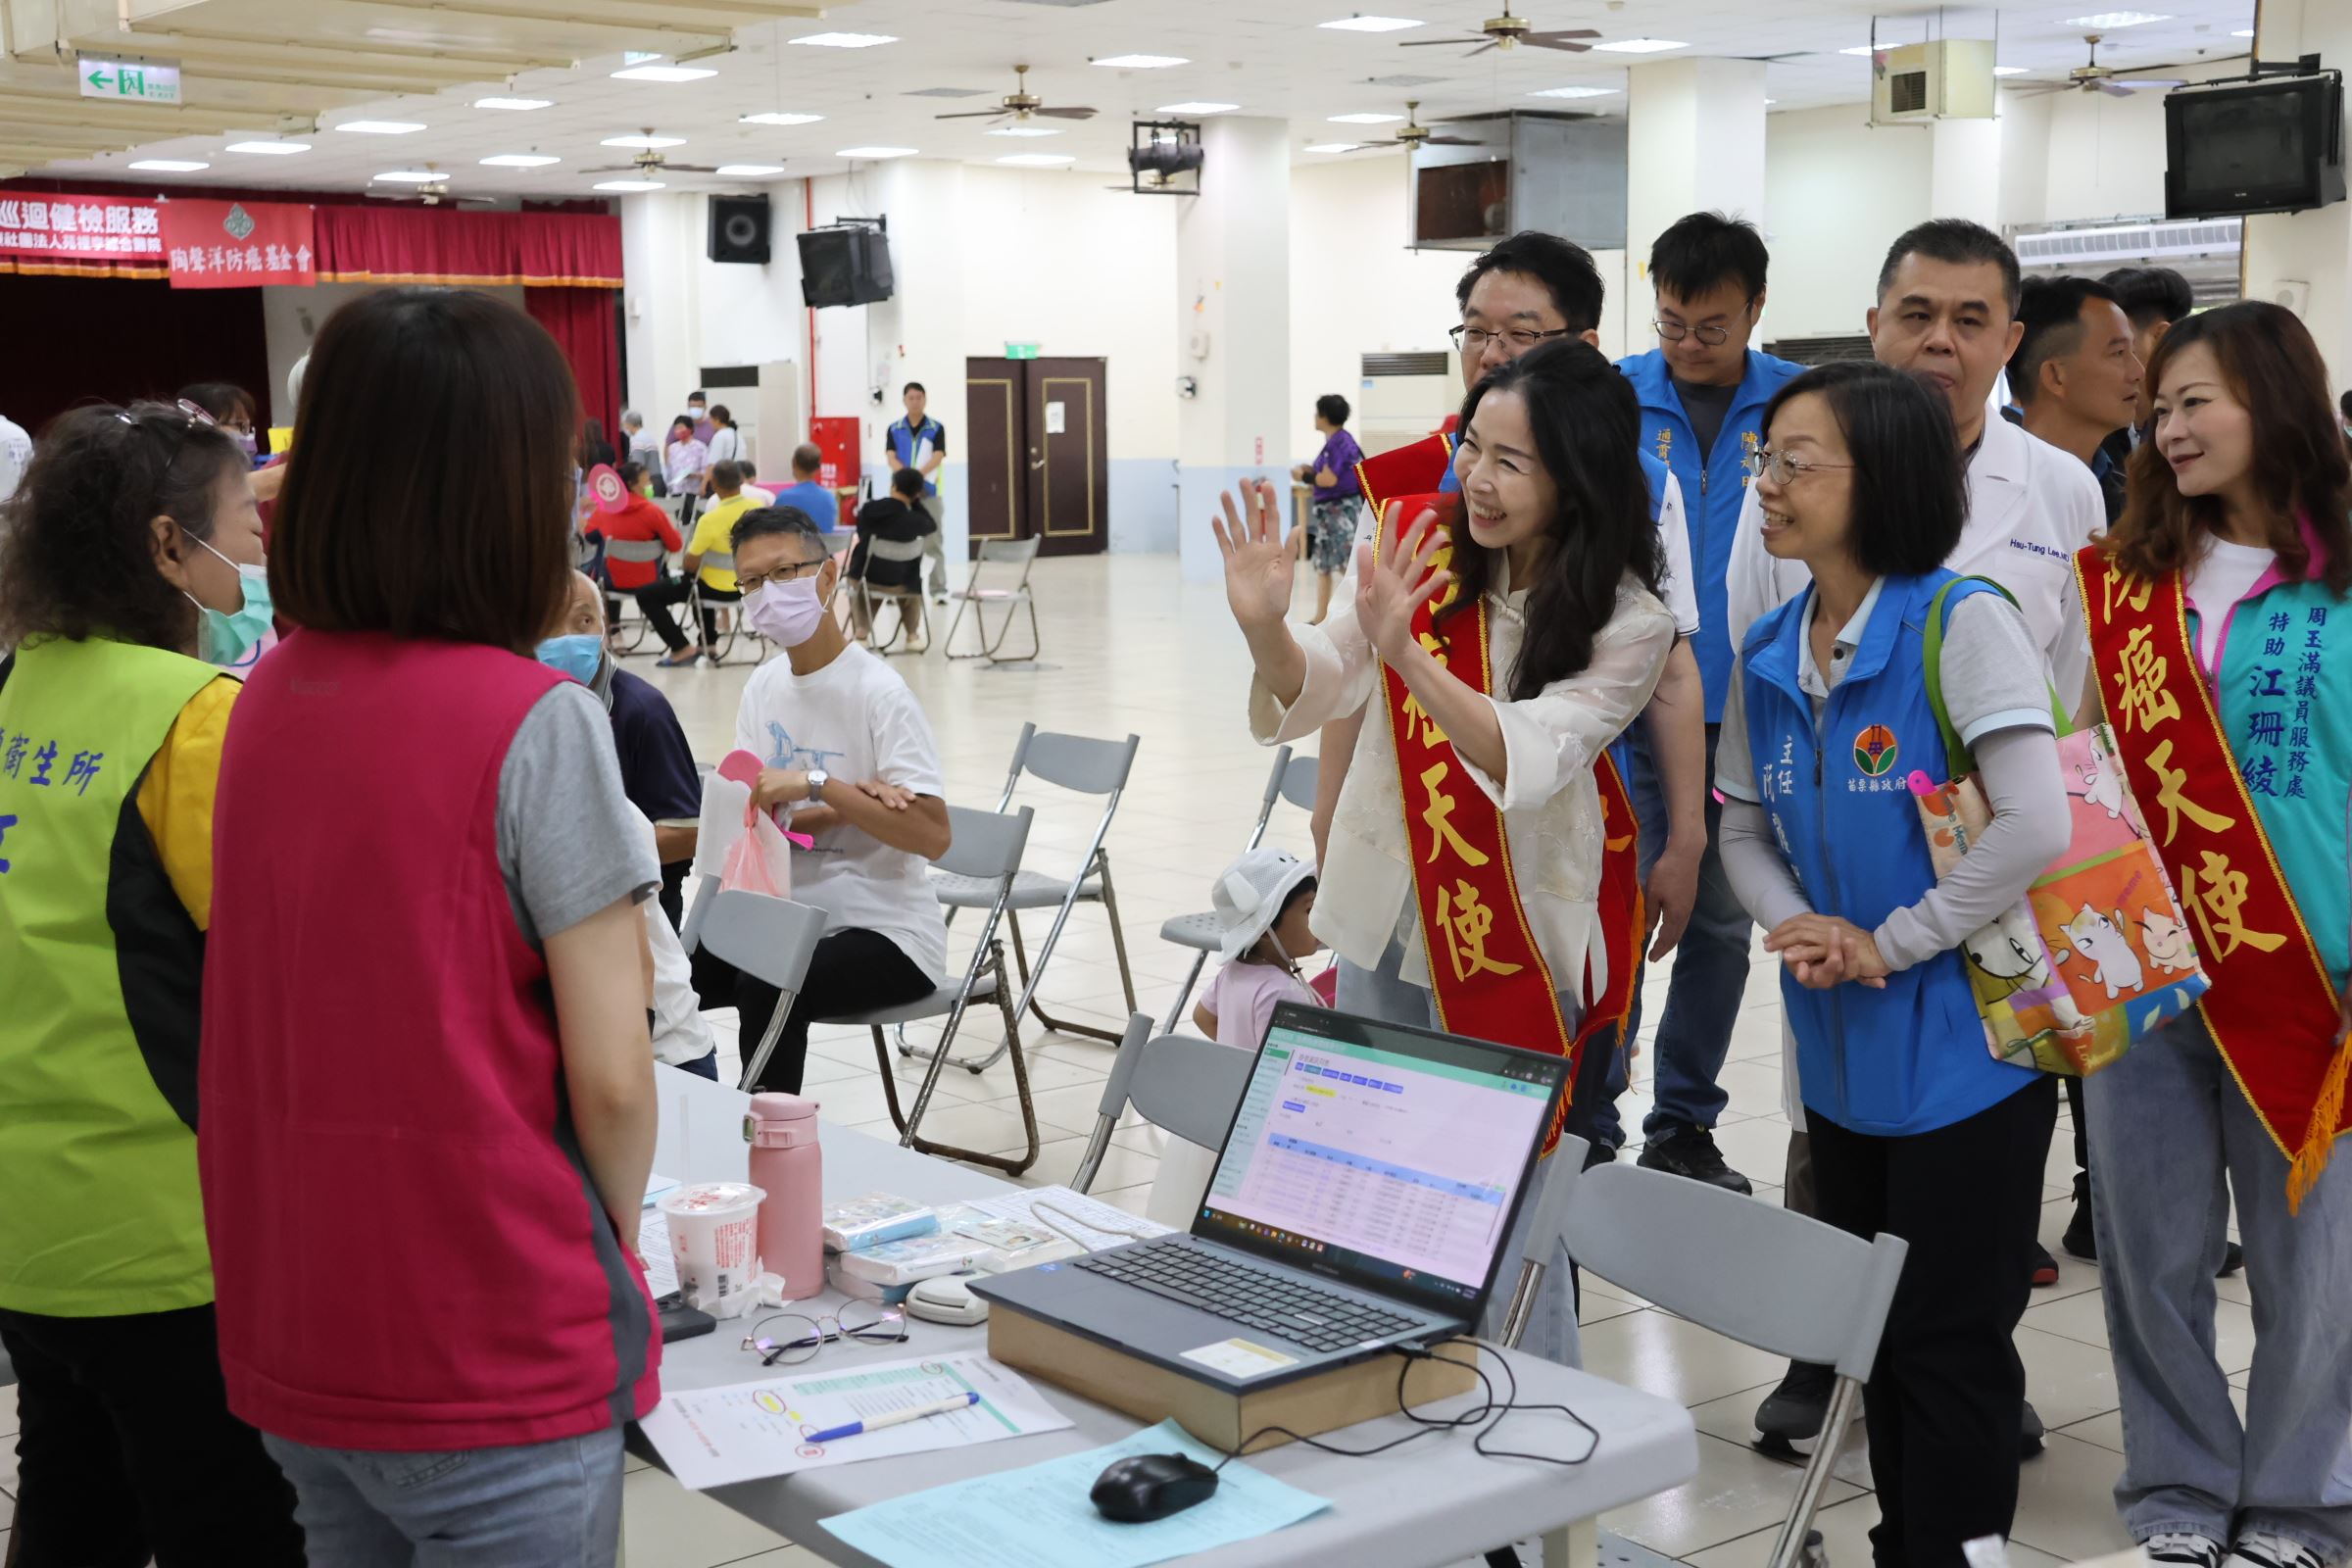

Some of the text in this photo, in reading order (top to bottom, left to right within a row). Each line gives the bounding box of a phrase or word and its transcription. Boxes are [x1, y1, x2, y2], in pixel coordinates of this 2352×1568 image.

[170, 244, 313, 275] 陶聲洋防癌基金會
[2263, 612, 2290, 657] 特助
[2283, 607, 2328, 800] 周玉滿議員服務處
[0, 727, 104, 797] 衛生所
[1778, 735, 1793, 795] 主任
[1847, 776, 1907, 793] 苗栗縣政府
[2103, 555, 2288, 964] 防癌天使
